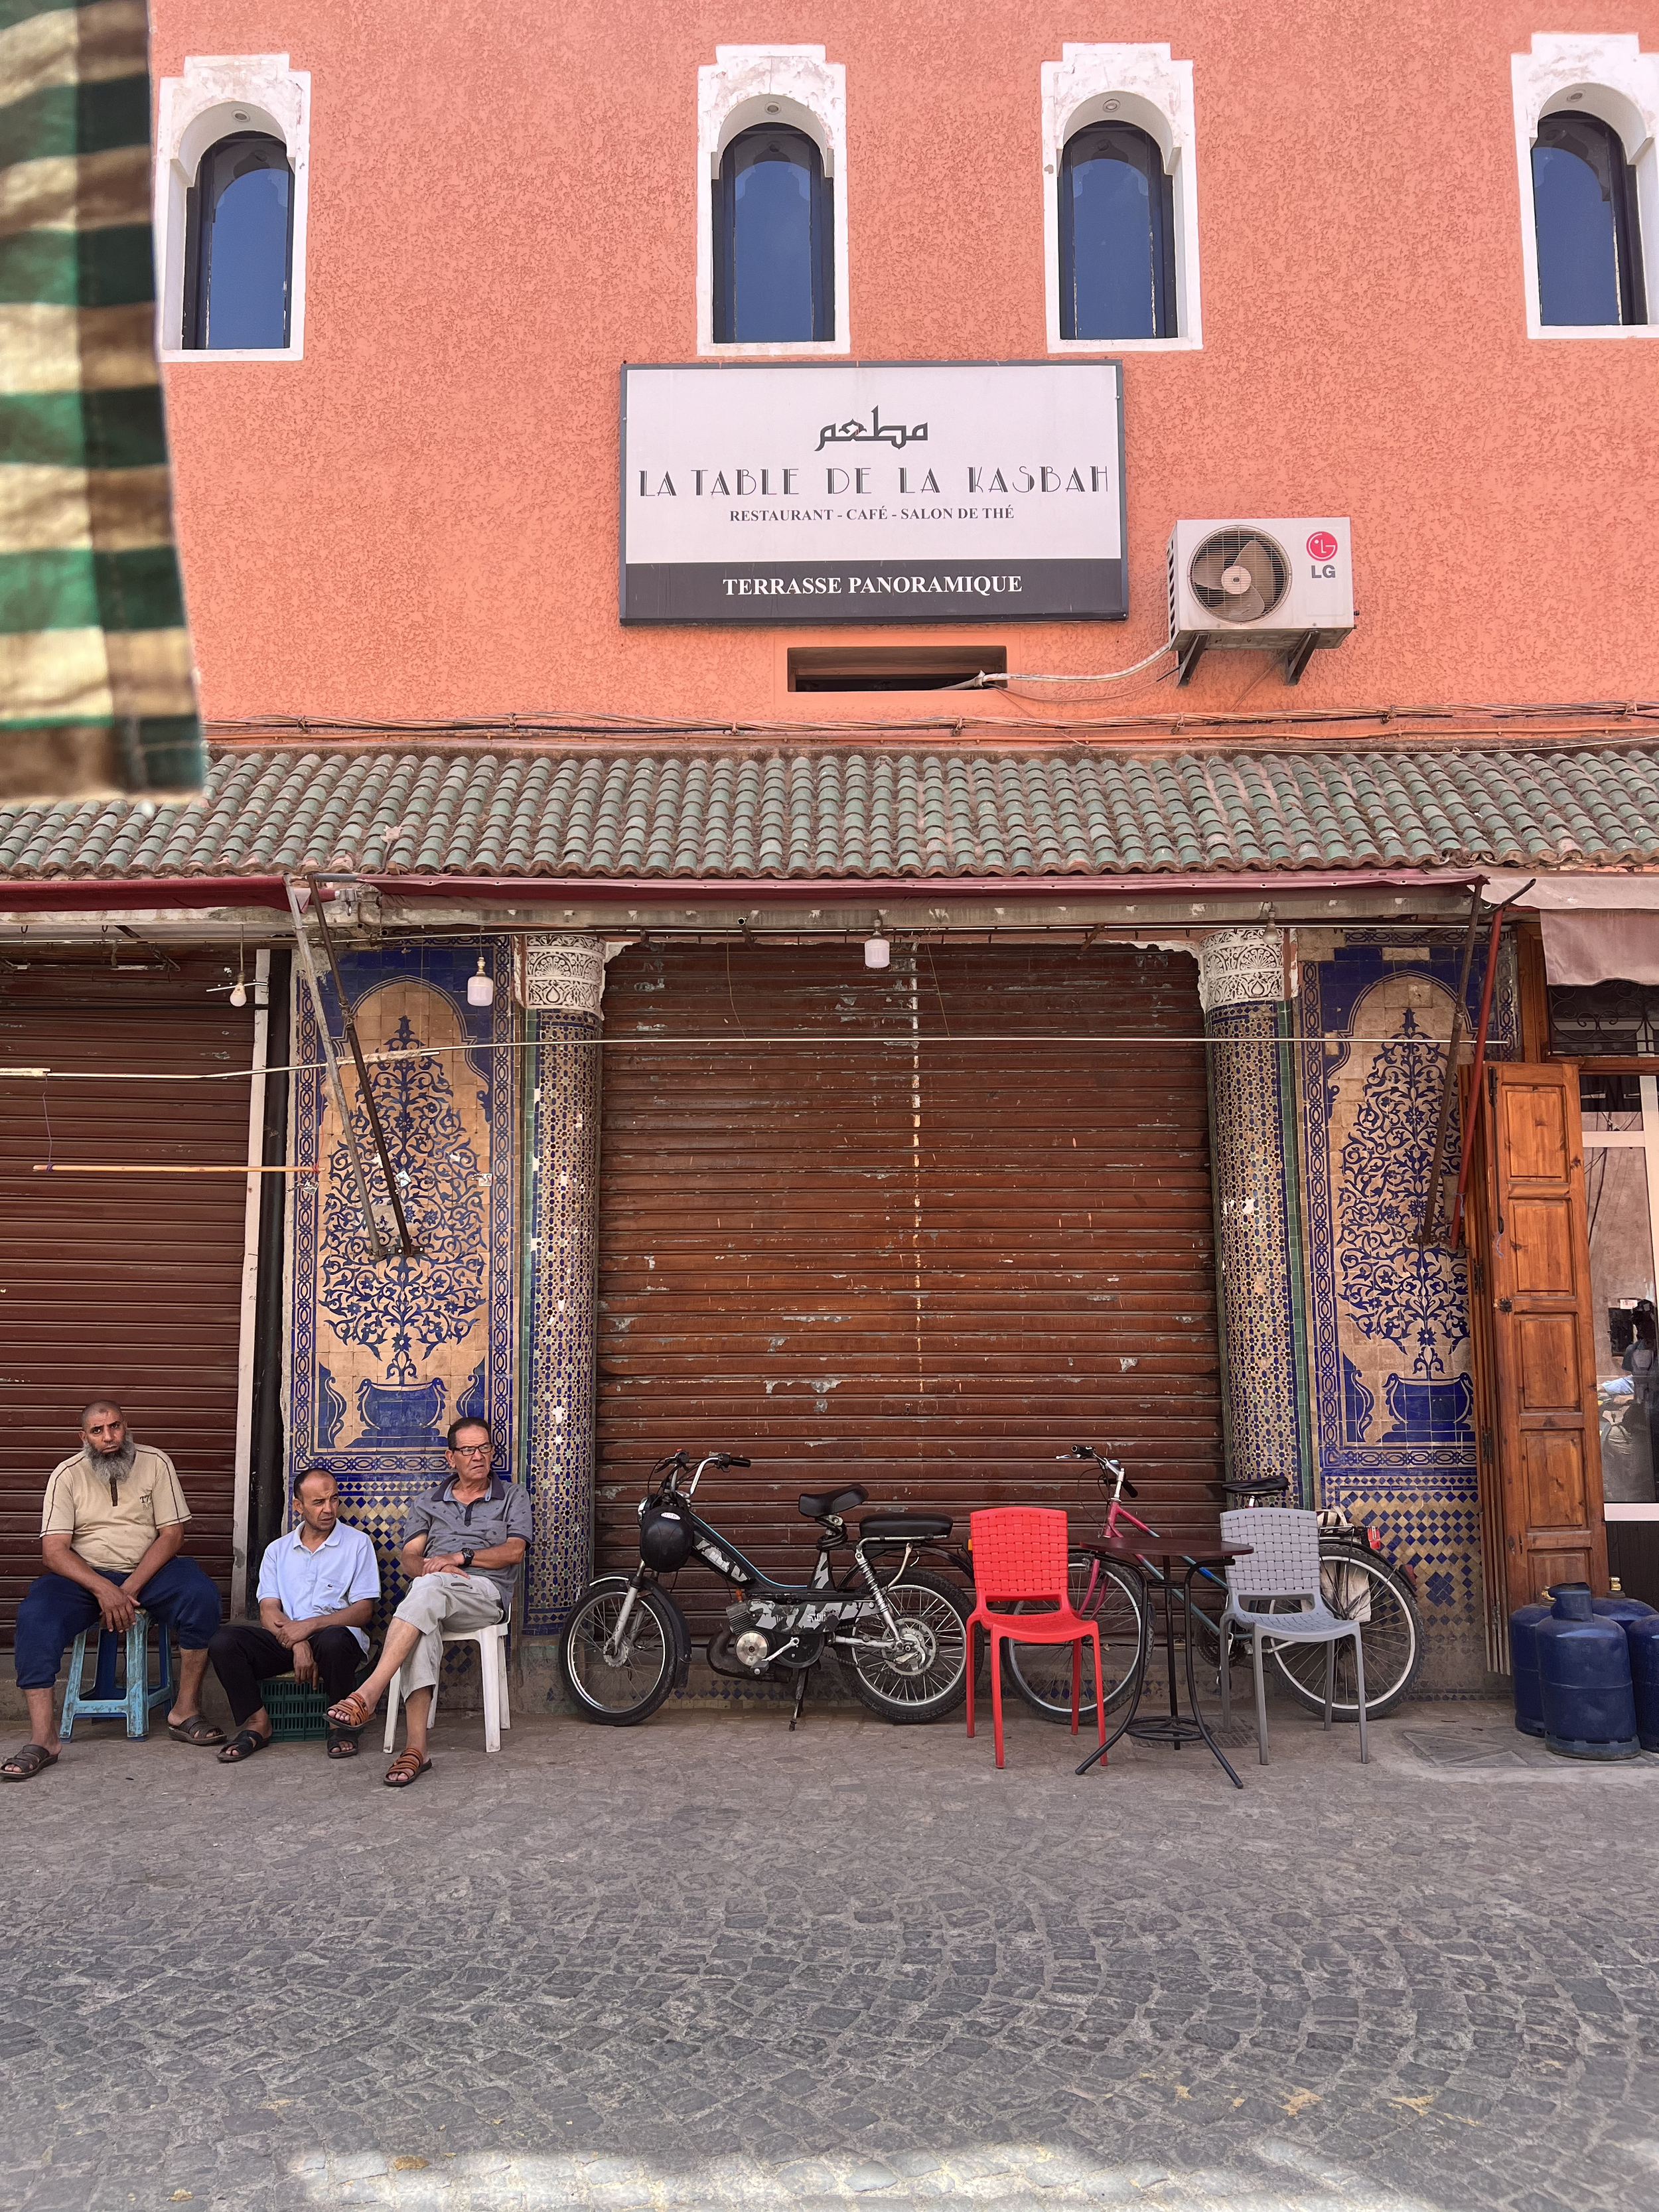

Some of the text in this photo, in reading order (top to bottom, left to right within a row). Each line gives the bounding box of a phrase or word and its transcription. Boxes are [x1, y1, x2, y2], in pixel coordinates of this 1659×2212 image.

[814, 405, 928, 452] مطعم
[639, 465, 1109, 497] LA TABLE DE LA KASBAH
[730, 509, 834, 522] RESTAURANT
[846, 505, 888, 520] CAFÉ
[901, 508, 953, 520] SALON
[958, 508, 978, 519] DE
[982, 504, 1015, 520] THÉ
[1311, 564, 1336, 579] LG
[722, 575, 1023, 597] TERRASSE PANORAMIQUE
